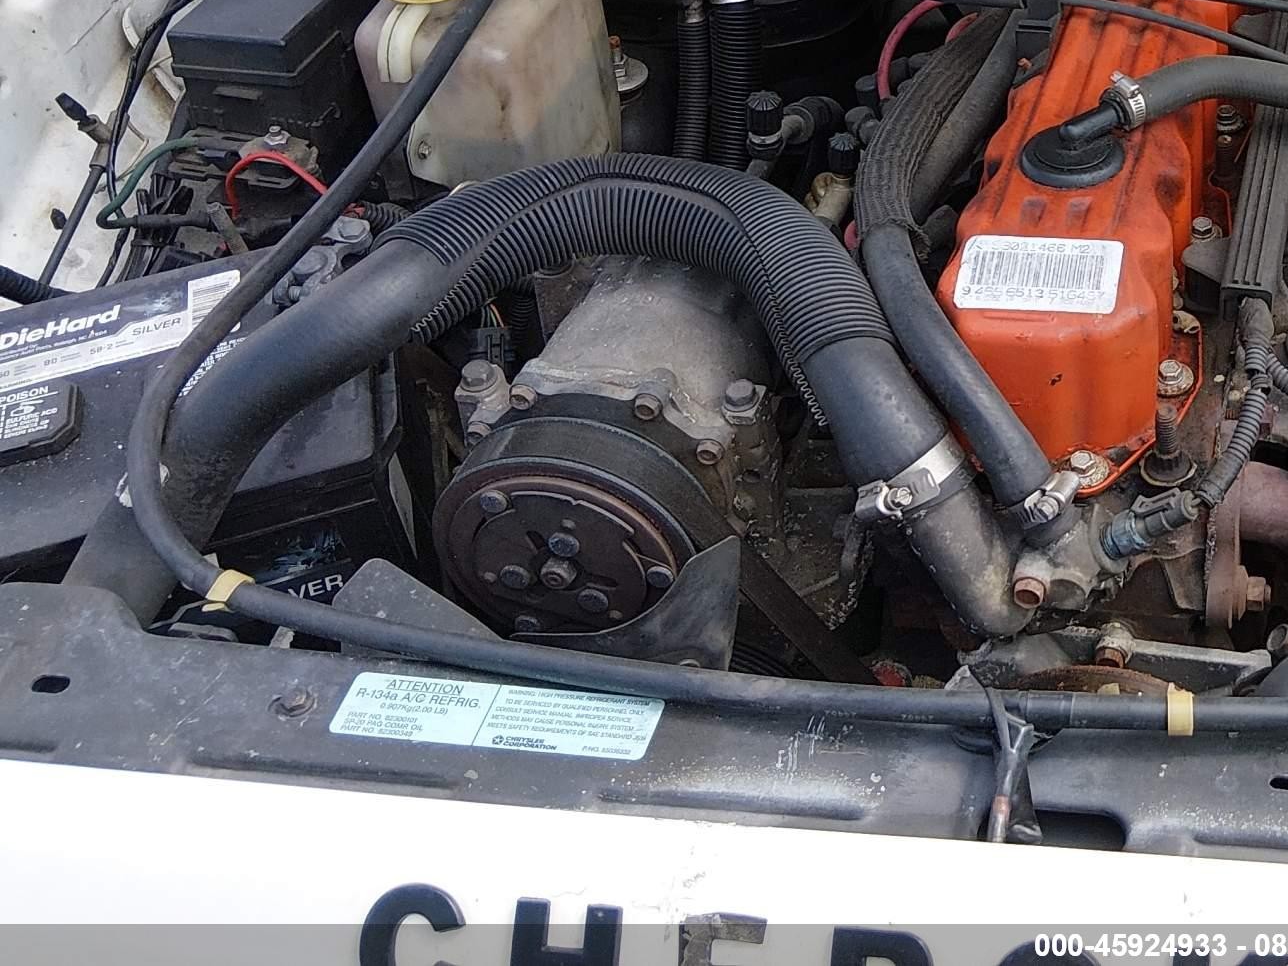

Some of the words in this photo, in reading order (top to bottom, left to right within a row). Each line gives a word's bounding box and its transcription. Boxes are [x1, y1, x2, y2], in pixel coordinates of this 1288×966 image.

[0, 304, 121, 348] DieHard
[132, 318, 182, 336] SILVER
[385, 678, 465, 695] ATTENTION
[354, 687, 400, 700] R-134a
[400, 691, 427, 703] A/C
[428, 694, 483, 708] REFRIG.
[585, 696, 625, 704] REFRIGERANT
[502, 740, 557, 750] CORPORATION
